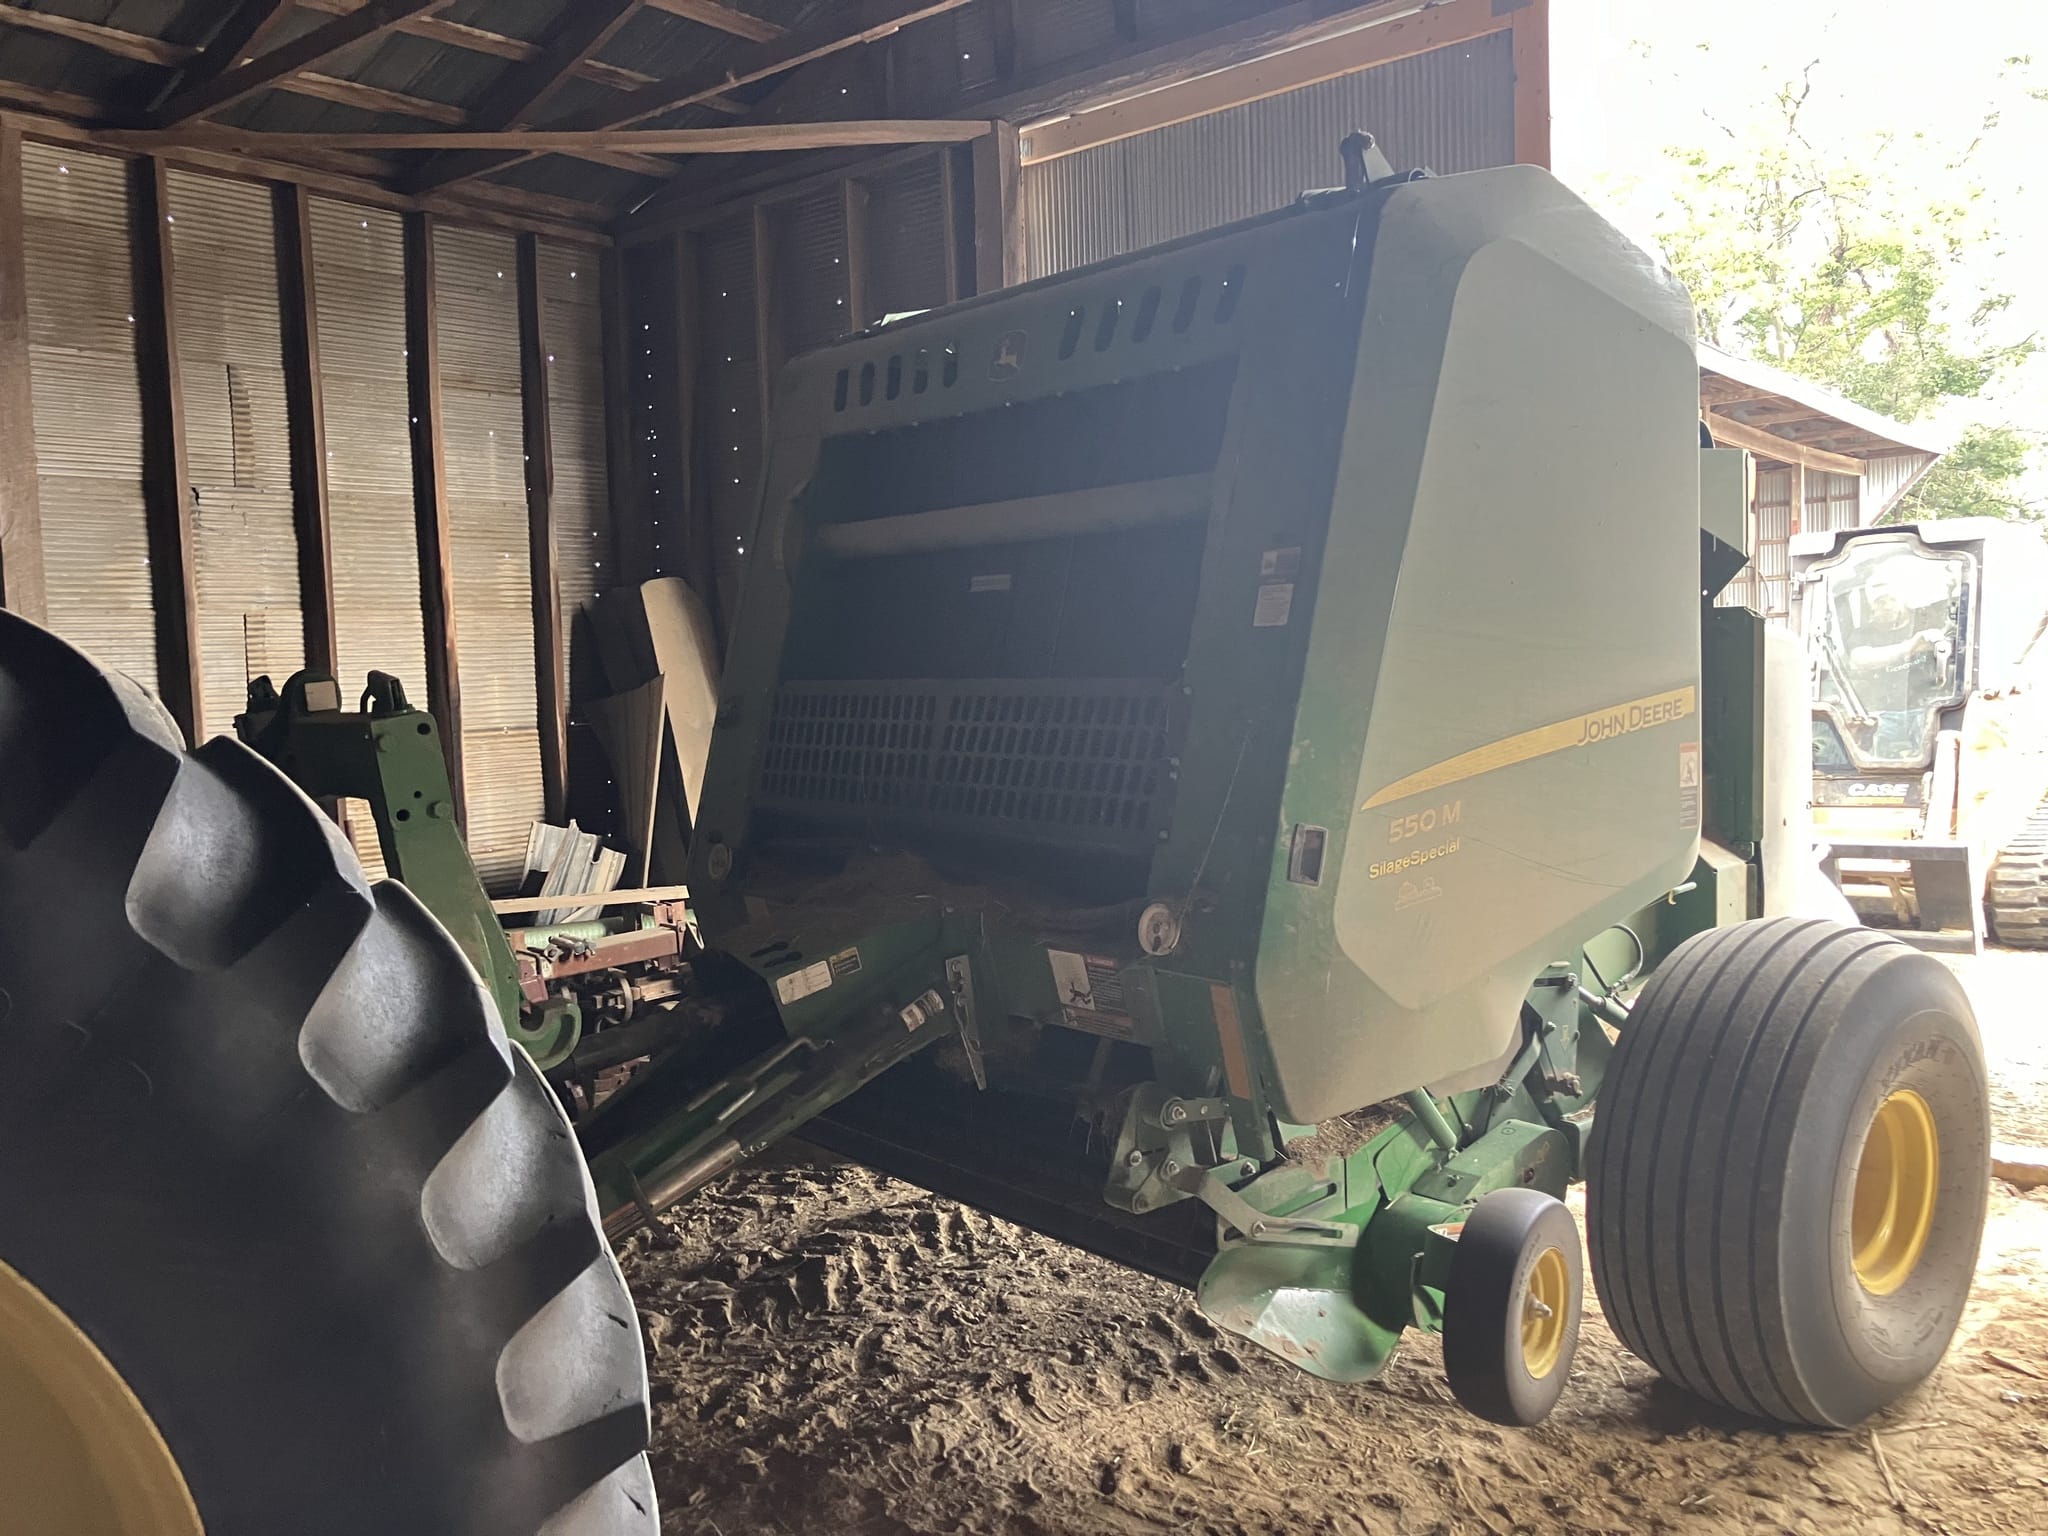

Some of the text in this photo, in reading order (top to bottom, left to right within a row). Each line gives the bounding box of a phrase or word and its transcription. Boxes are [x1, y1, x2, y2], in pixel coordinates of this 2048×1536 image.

[1578, 698, 1684, 745] JOHN DEERE
[1848, 783, 1909, 797] CASE
[1388, 798, 1463, 844] 550 M
[1368, 837, 1461, 880] SilageSpecial
